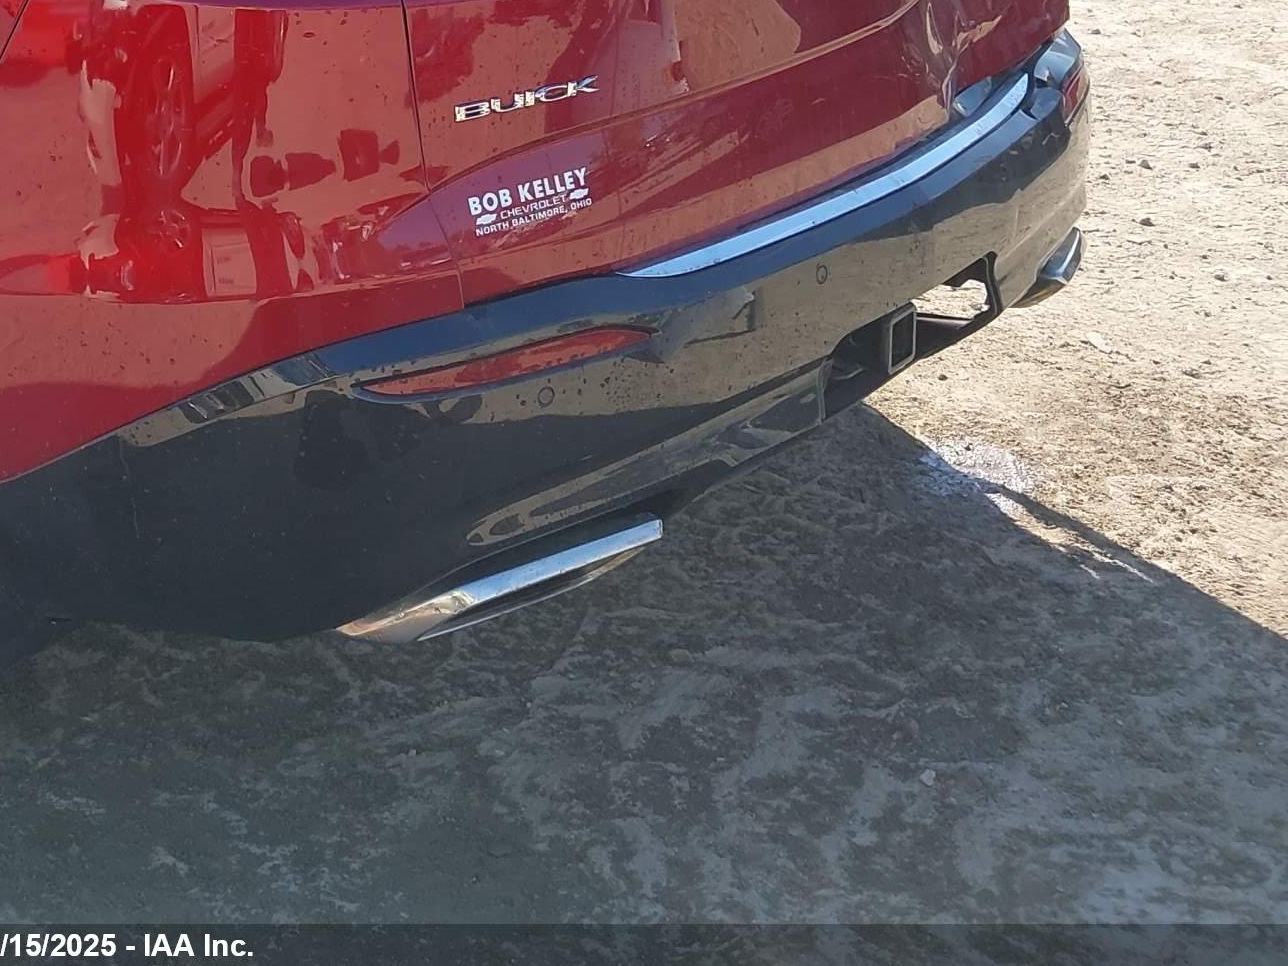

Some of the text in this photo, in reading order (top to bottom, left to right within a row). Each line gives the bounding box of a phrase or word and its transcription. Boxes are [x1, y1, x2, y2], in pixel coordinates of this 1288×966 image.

[454, 75, 600, 122] BUICK
[468, 166, 587, 216] BOB KELLEY
[500, 194, 567, 220] CHEVROLET
[475, 197, 592, 237] NORTH BALTIMORE, OHIO
